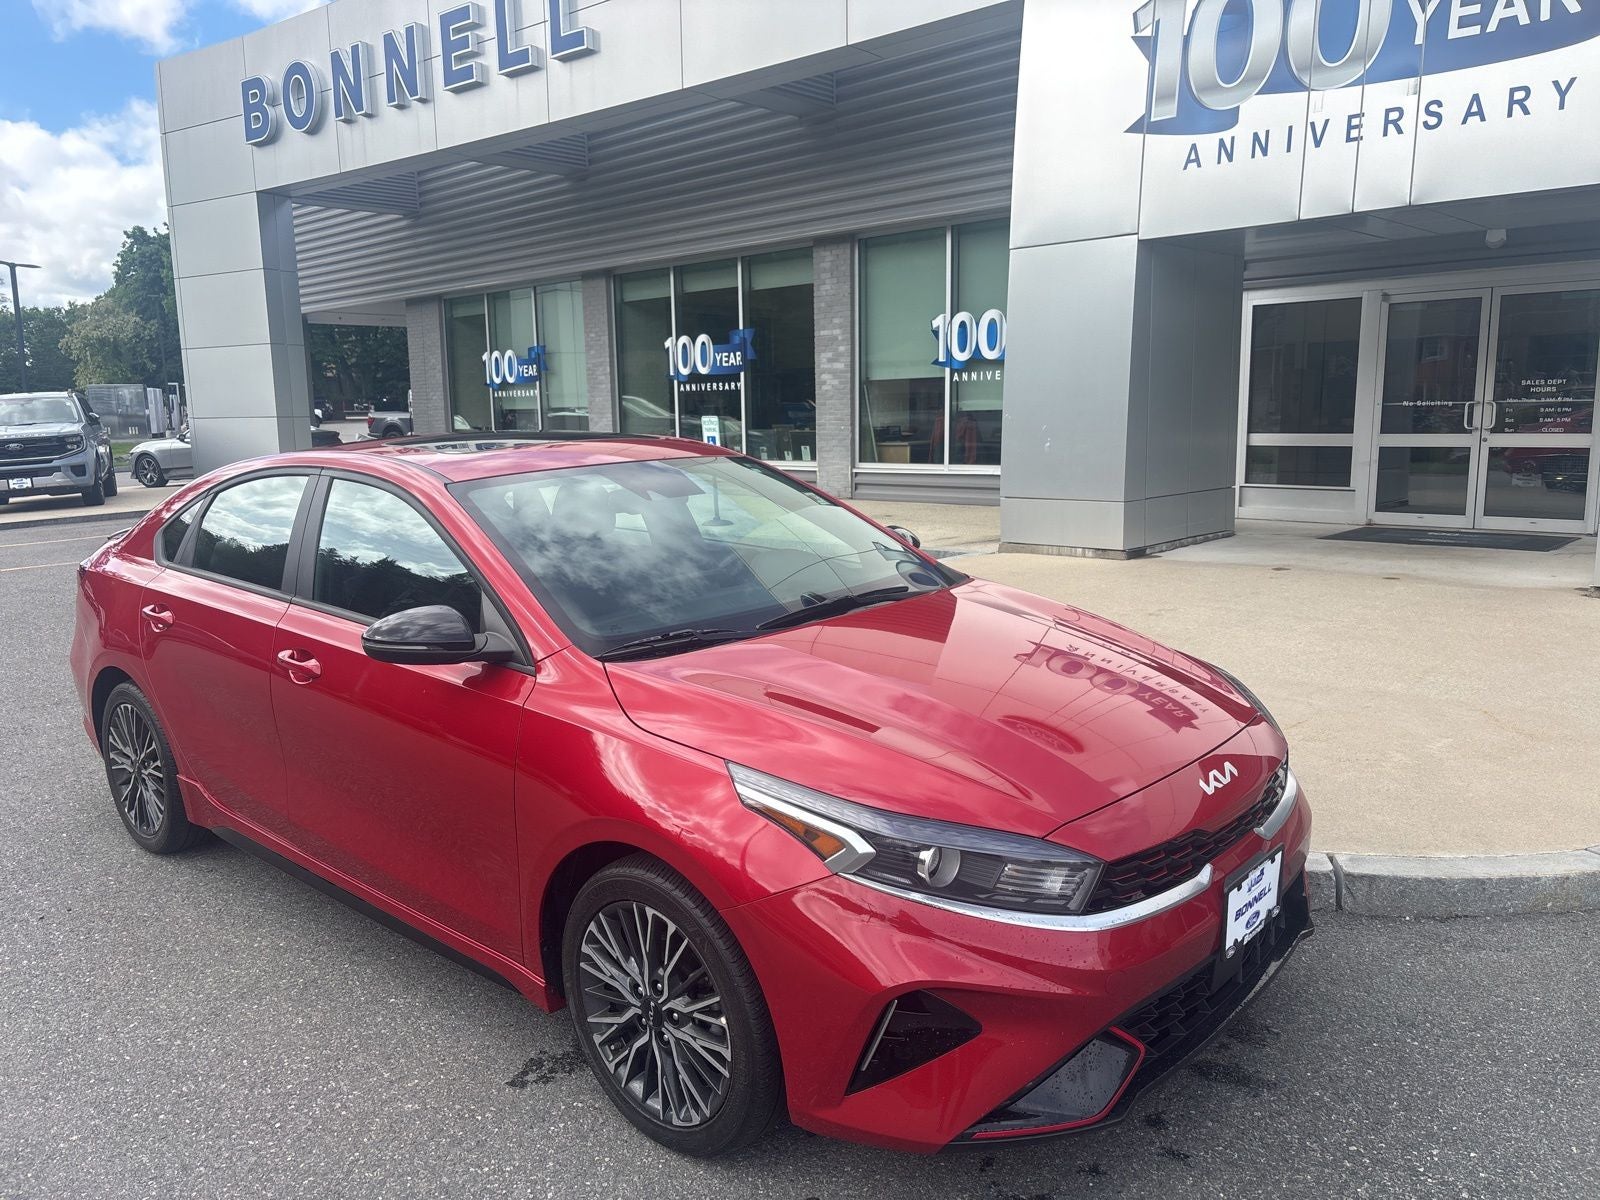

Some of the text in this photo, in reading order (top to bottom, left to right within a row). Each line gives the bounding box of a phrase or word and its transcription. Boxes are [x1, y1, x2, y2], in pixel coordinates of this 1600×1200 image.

[240, 0, 596, 146] BONNELL
[1133, 0, 1393, 122] 100
[1182, 77, 1578, 171] ANNIVERSARY
[664, 334, 743, 376] 100 YEAR
[931, 309, 1007, 362] 100
[482, 349, 538, 385] 100 YEAR
[680, 382, 742, 392] ANNIVERSARY
[494, 389, 538, 398] ANNIVERSARY
[1234, 881, 1272, 922] BONNELL
